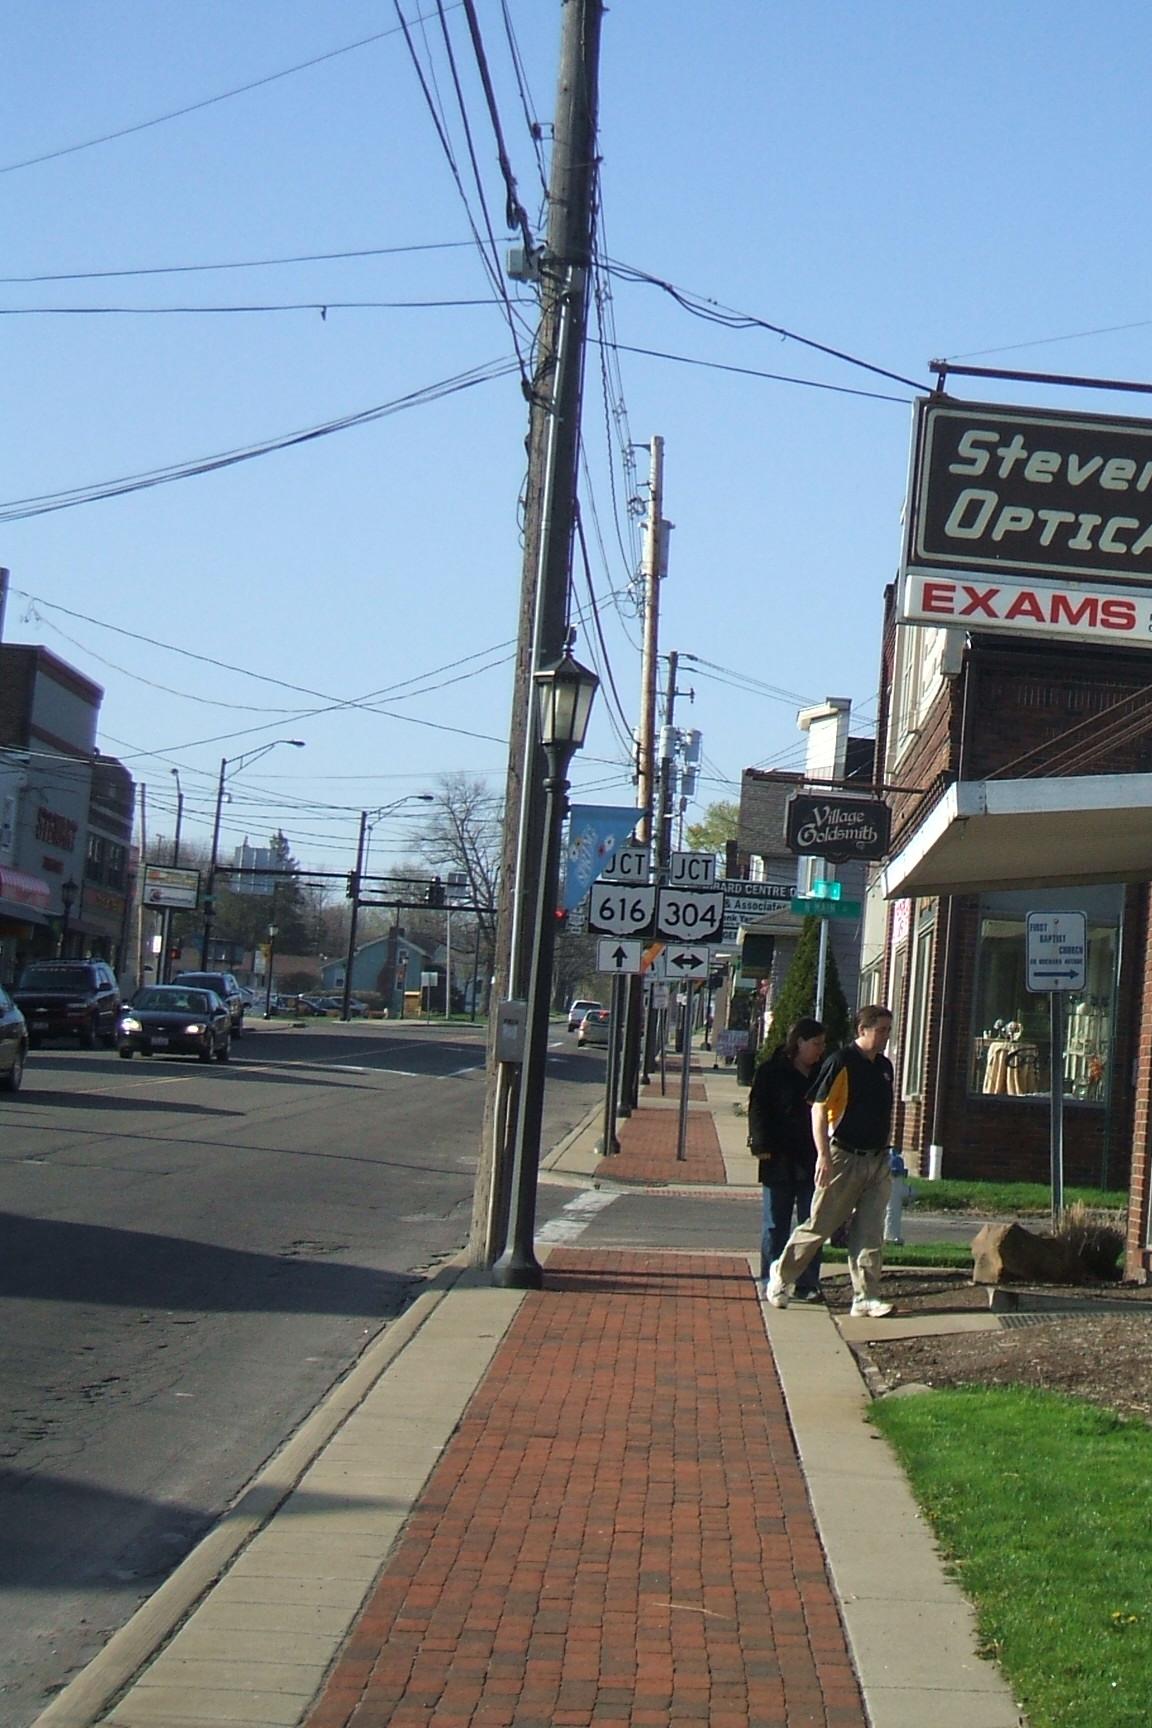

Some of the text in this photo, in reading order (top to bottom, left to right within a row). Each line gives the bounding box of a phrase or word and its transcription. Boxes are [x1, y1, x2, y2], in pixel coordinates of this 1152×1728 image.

[921, 582, 1137, 631] EXAMS
[812, 805, 865, 827] Village
[797, 823, 878, 850] Goldsmith
[605, 853, 646, 875] JCT
[674, 858, 713, 880] JCT
[745, 885, 786, 897] CENTRE
[599, 897, 645, 922] 616
[664, 902, 717, 928] 304
[1030, 923, 1048, 932] FIRST
[1040, 934, 1066, 943] BAPTIST
[1059, 946, 1083, 954] CHURCH
